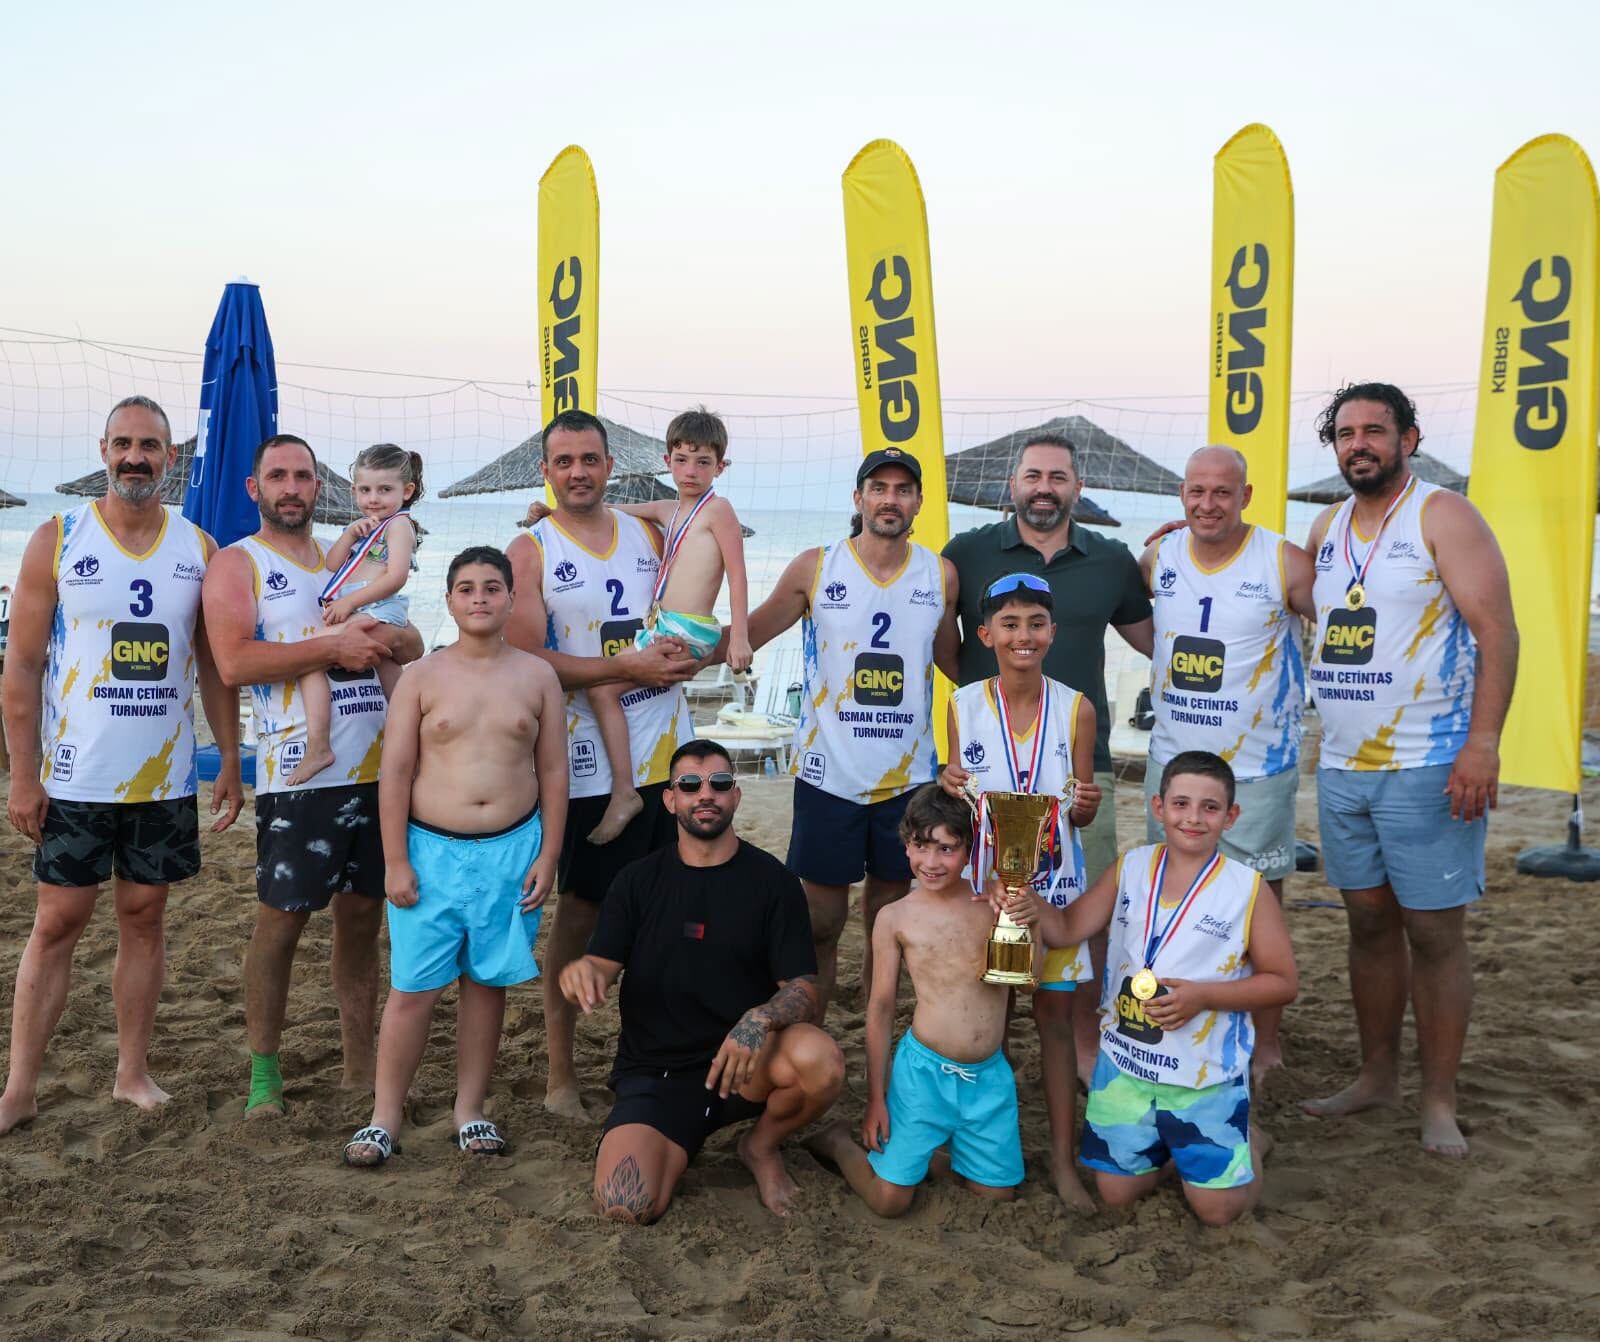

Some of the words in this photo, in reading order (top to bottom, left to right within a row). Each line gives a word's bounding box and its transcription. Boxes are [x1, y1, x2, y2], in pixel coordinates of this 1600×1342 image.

[129, 579, 153, 617] 3
[606, 578, 629, 616] 2
[1198, 596, 1213, 633] 1
[871, 612, 891, 649] 2
[1326, 624, 1375, 650] GNÇ
[112, 640, 169, 666] GNÇ
[603, 638, 633, 657] GN
[1172, 651, 1223, 680] GNÇ
[855, 668, 903, 693] GNÇ
[1338, 670, 1393, 685] ÇETİNTAŞ
[93, 686, 133, 699] OSMAN
[331, 687, 357, 702] MAN
[620, 687, 670, 707] URNUVAS
[1318, 687, 1375, 701] TURNUVASI
[110, 704, 167, 717] TURNUVASI
[1190, 697, 1239, 712] ÇETİNTAŞ
[839, 711, 873, 722] OSMAN
[1171, 709, 1222, 726] TURNUVASI
[853, 727, 904, 738] TURNUVASI
[576, 744, 591, 756] 10.
[810, 756, 822, 768] 10.
[1131, 1046, 1179, 1071] ÇETİNTAŞ
